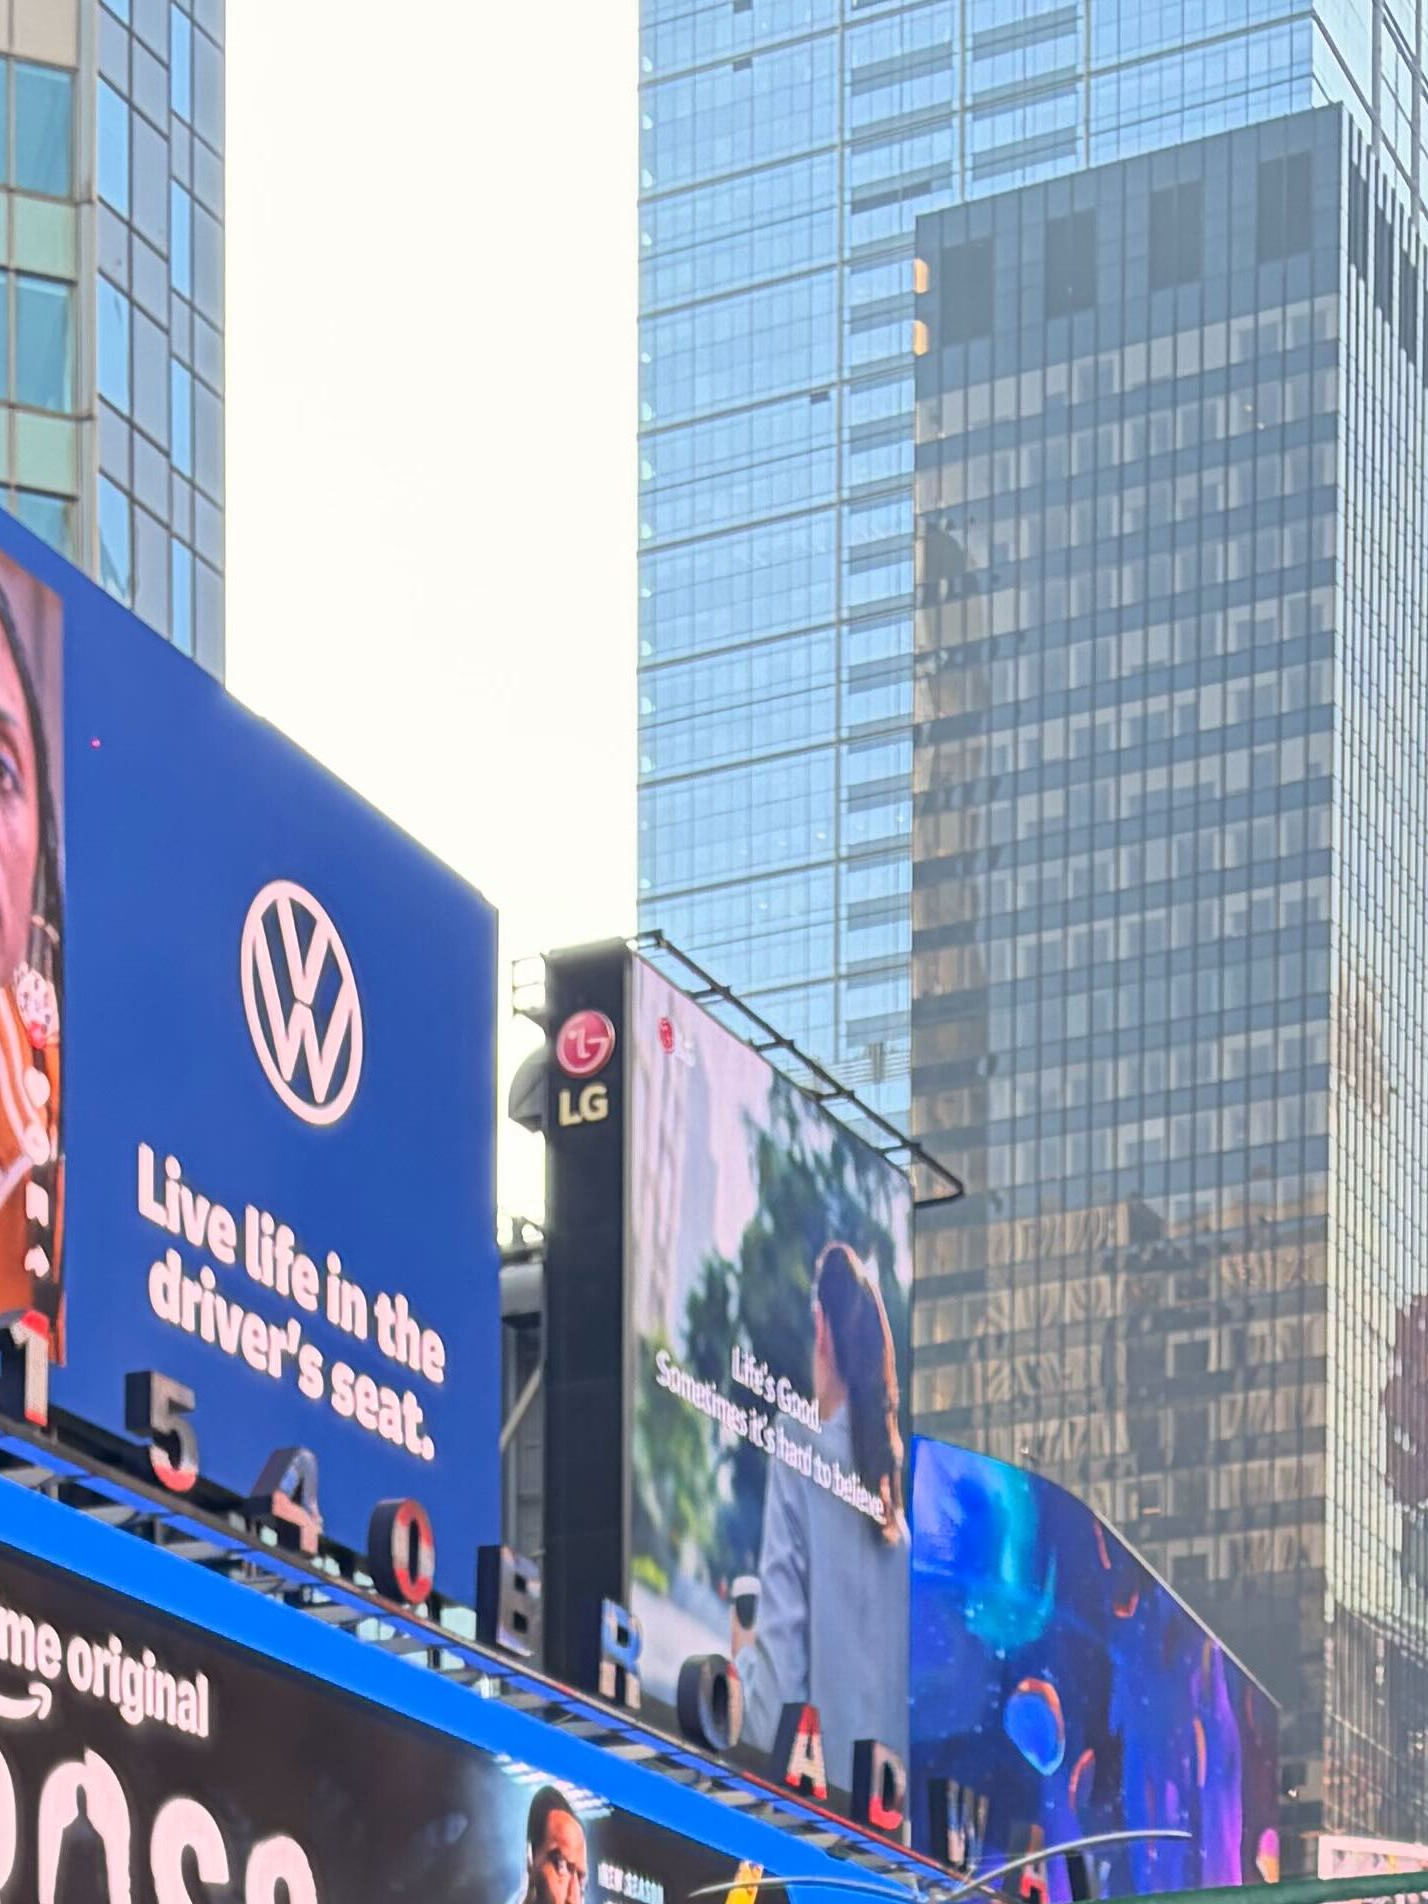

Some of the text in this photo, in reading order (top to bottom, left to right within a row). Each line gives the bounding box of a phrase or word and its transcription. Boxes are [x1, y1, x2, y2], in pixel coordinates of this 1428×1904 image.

[558, 1081, 608, 1127] LG
[137, 1141, 447, 1386] Live life in the
[148, 1248, 437, 1463] driver's seat.
[731, 1343, 776, 1404] Life's
[655, 1348, 748, 1437] Sometimes
[748, 1406, 776, 1455] it's
[776, 1423, 813, 1478] hard
[813, 1455, 832, 1489] to
[68, 1631, 210, 1740] original
